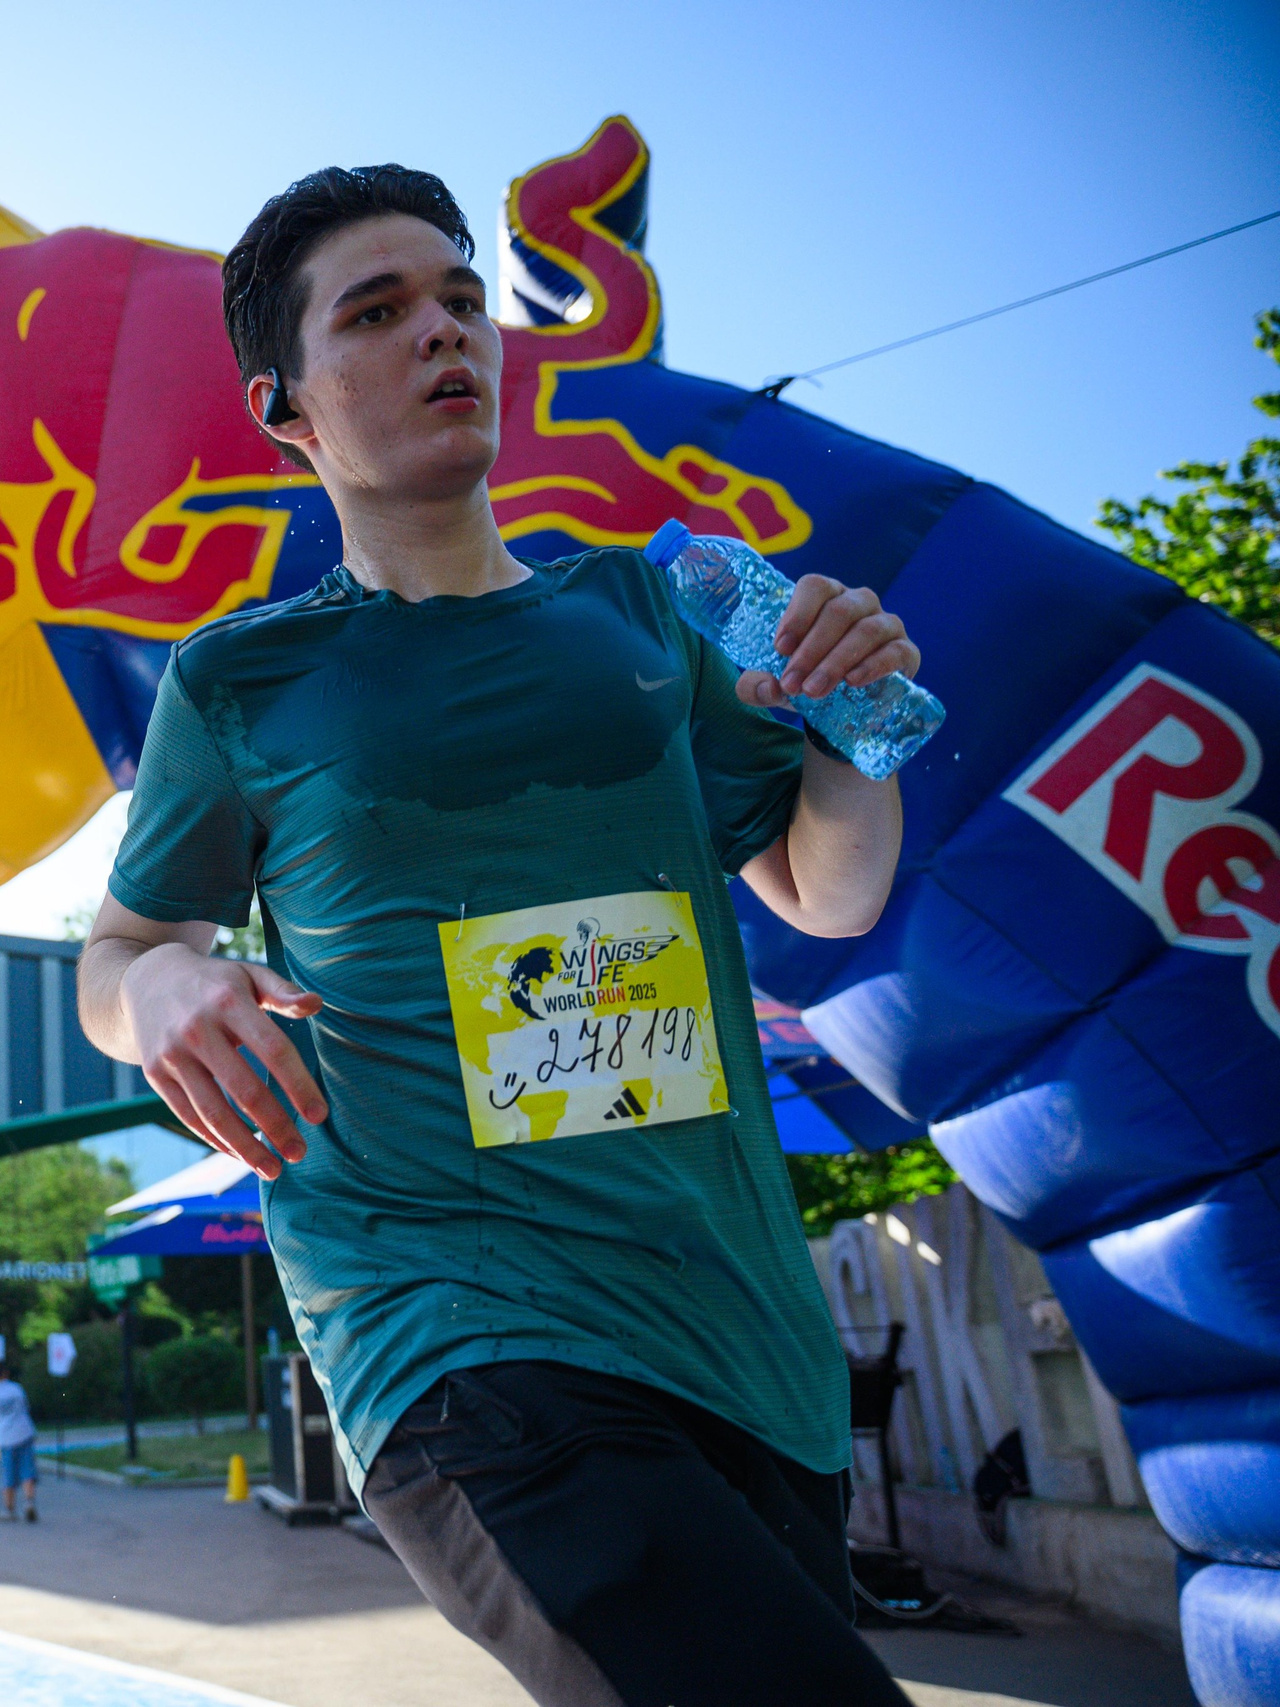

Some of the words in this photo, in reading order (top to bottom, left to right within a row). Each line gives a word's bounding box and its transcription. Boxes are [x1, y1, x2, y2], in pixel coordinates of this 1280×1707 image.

[1010, 666, 1280, 1026] Re
[560, 939, 645, 969] WINGS
[558, 970, 577, 981] FOR
[577, 963, 626, 988] LIFE
[628, 982, 657, 1001] 2025
